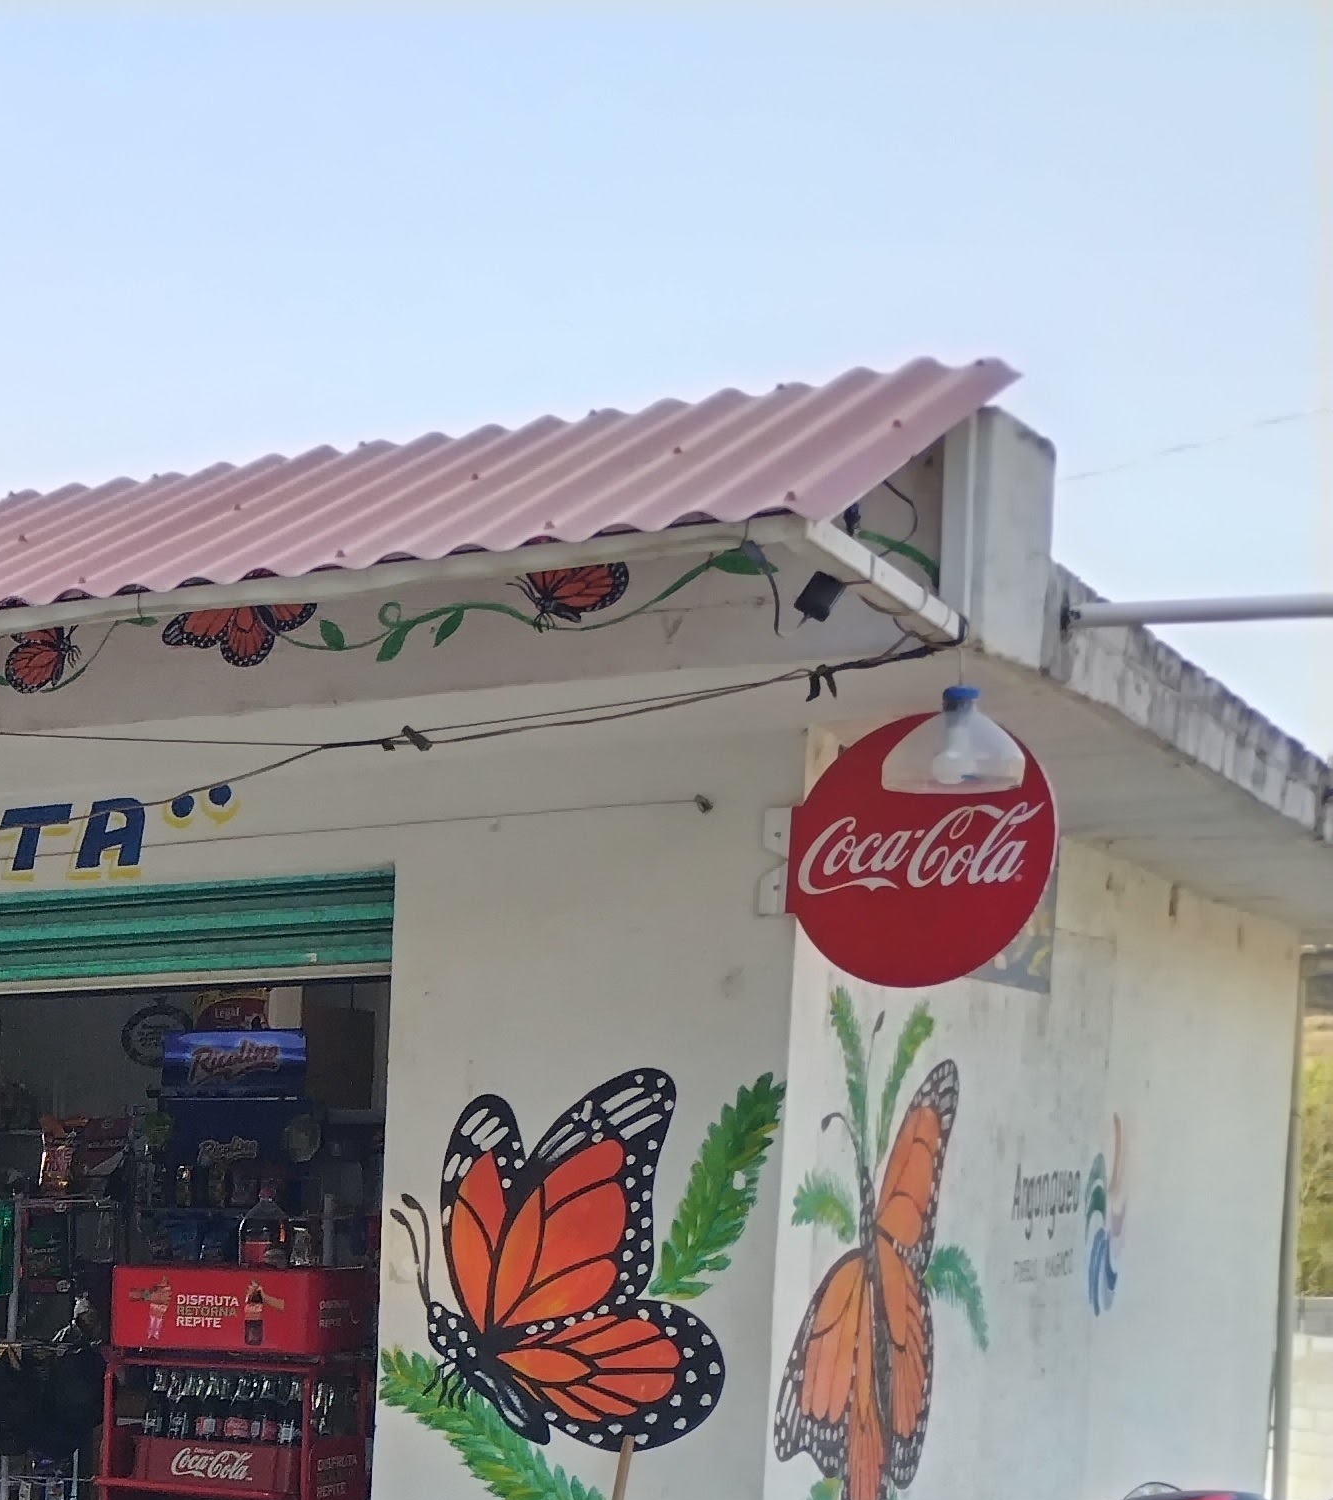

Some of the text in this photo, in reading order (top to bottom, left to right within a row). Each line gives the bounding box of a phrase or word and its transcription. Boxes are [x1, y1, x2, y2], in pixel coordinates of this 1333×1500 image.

[797, 801, 1045, 896] Coca-Cola
[176, 1294, 240, 1307] DISFRUTA
[176, 1306, 238, 1317] RETORNA
[176, 1316, 222, 1328] REPITE
[171, 1447, 253, 1481] Coca-Cola
